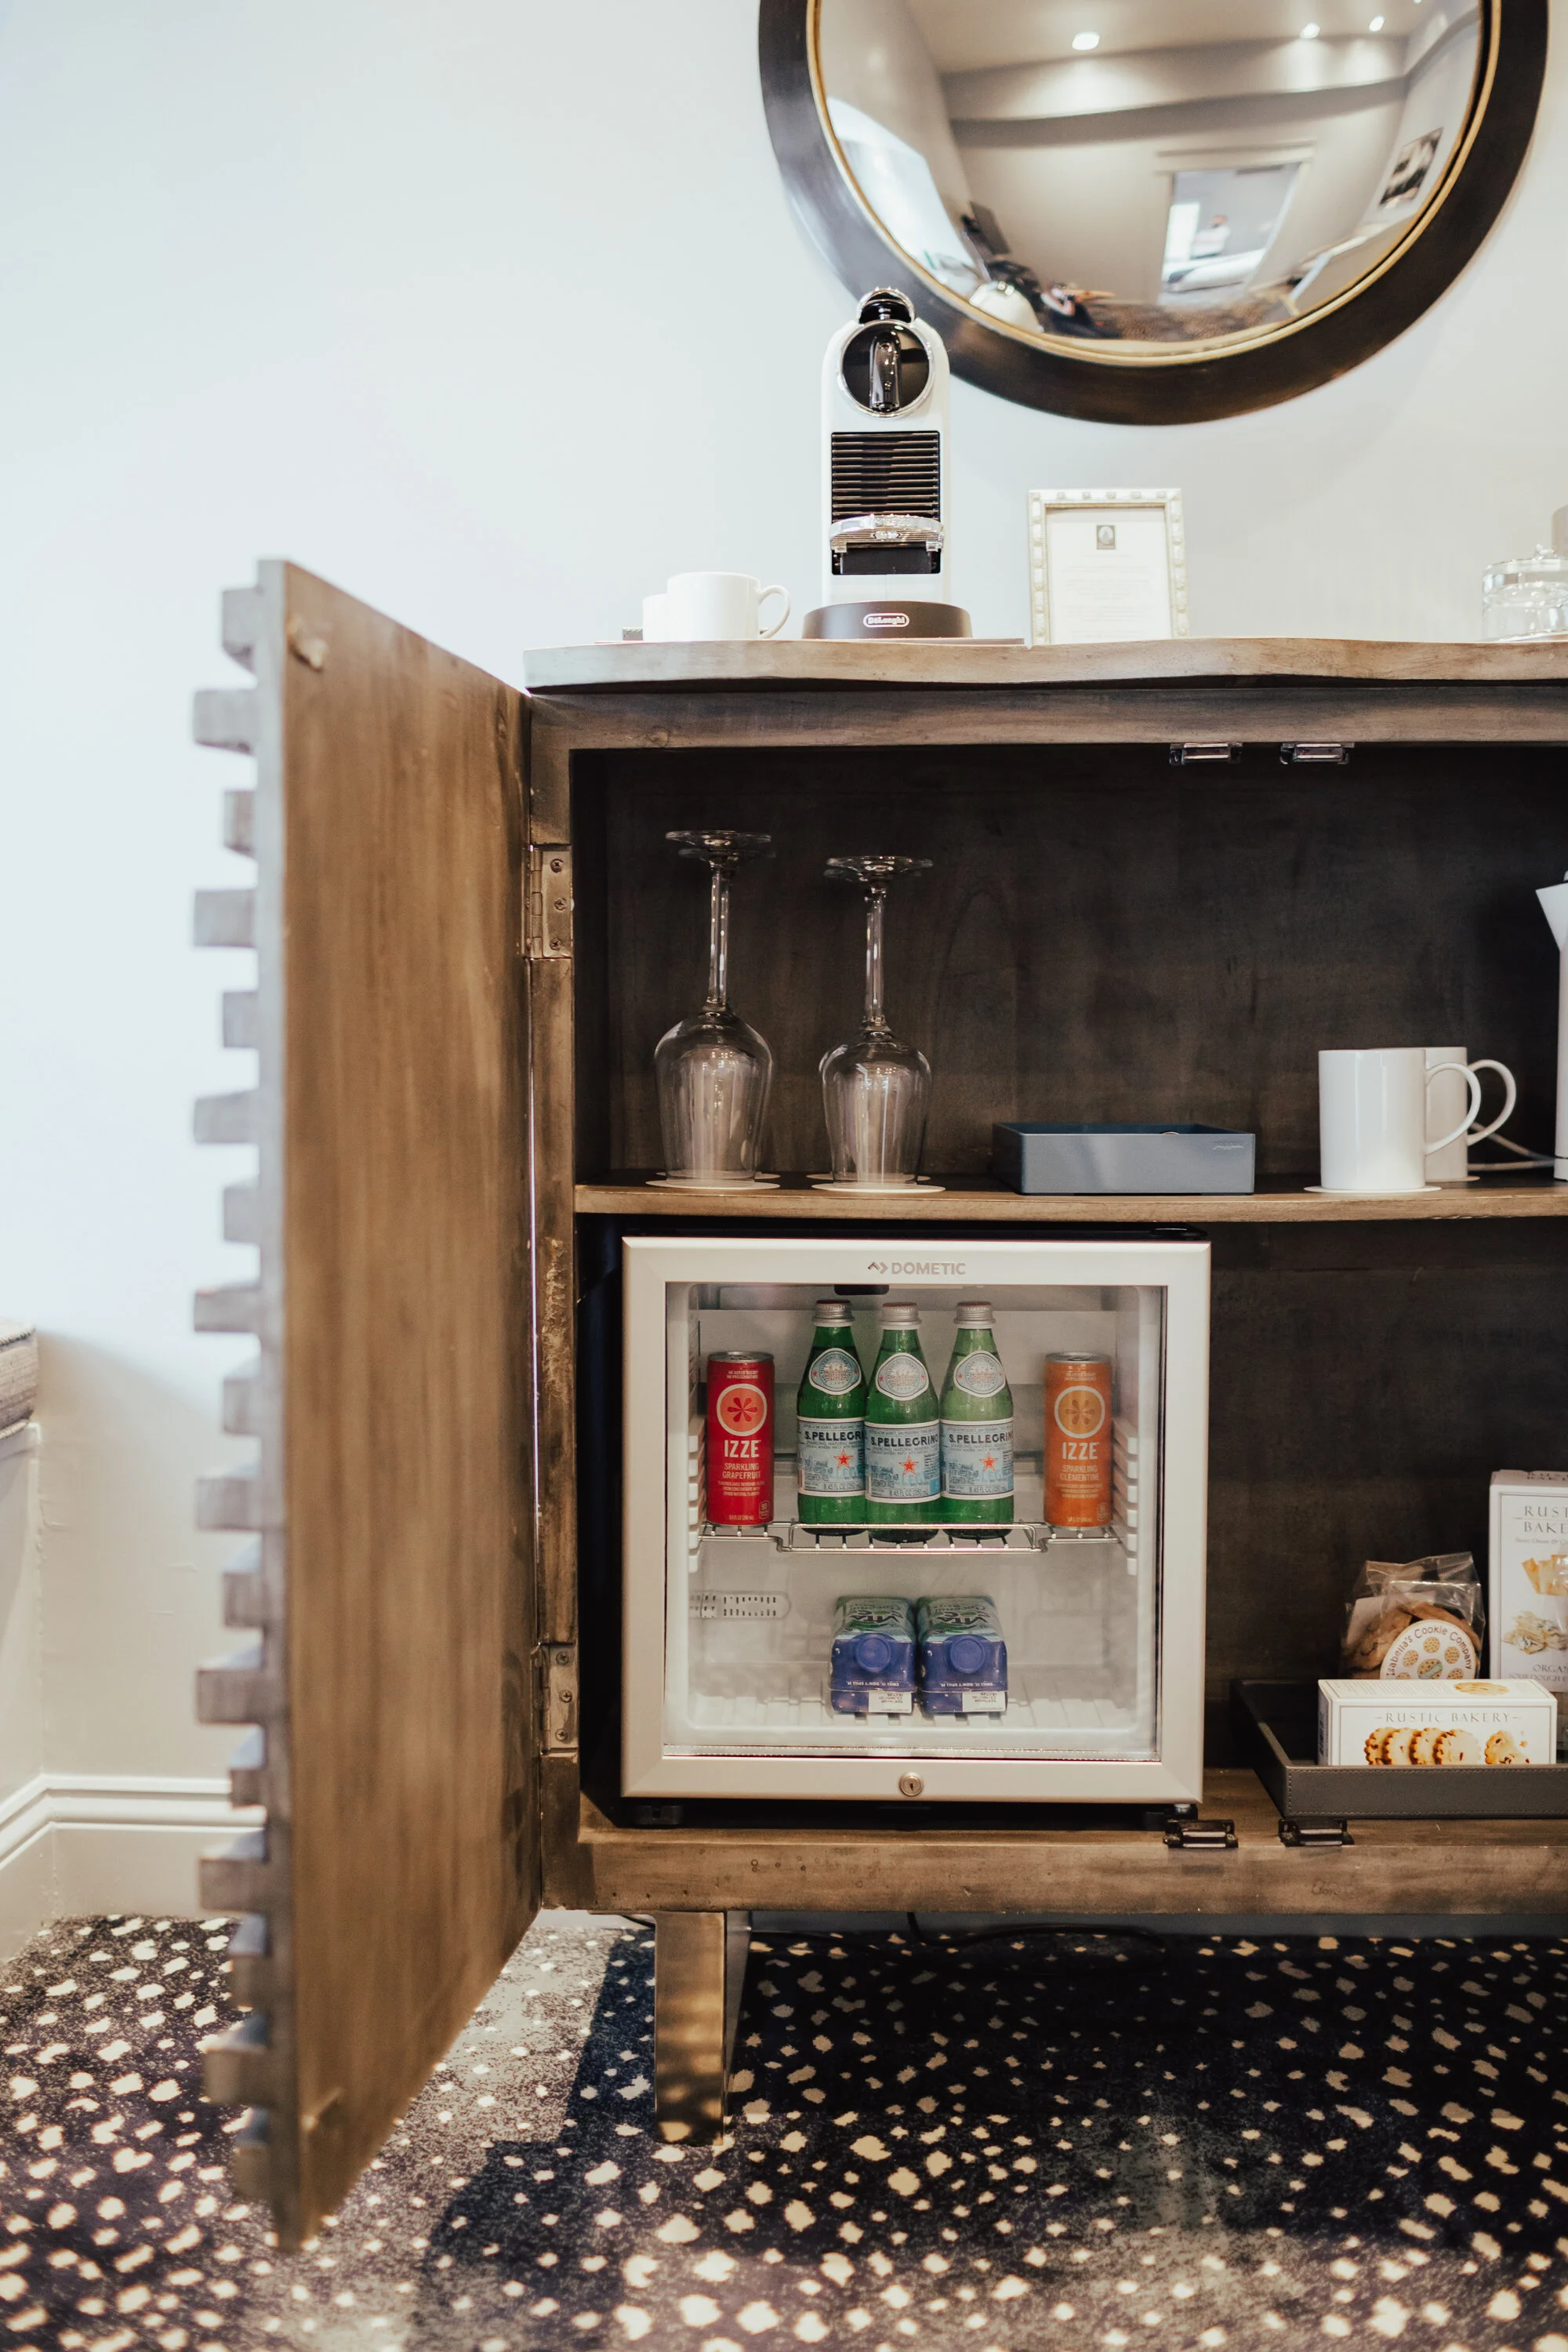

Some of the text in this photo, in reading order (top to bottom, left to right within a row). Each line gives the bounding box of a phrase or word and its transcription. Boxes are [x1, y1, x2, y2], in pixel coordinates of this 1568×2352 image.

[891, 1261, 967, 1275] DOMETIC
[804, 1430, 865, 1442] S.PELLEGRI
[949, 1429, 1014, 1443] S.PELLEGRIN
[724, 1439, 760, 1458] IZZE
[1062, 1442, 1098, 1460] IZZE
[724, 1463, 760, 1472] SPARKLING
[1062, 1465, 1098, 1473] SPARKLING
[722, 1471, 761, 1479] GRAPEFRUIT
[1060, 1473, 1100, 1482] CLEMENTINE
[937, 1616, 988, 1625] VITA
[1386, 1626, 1472, 1676] Isabella's Cookie Company
[1386, 1712, 1508, 1722] RUSTIC BAKERY
